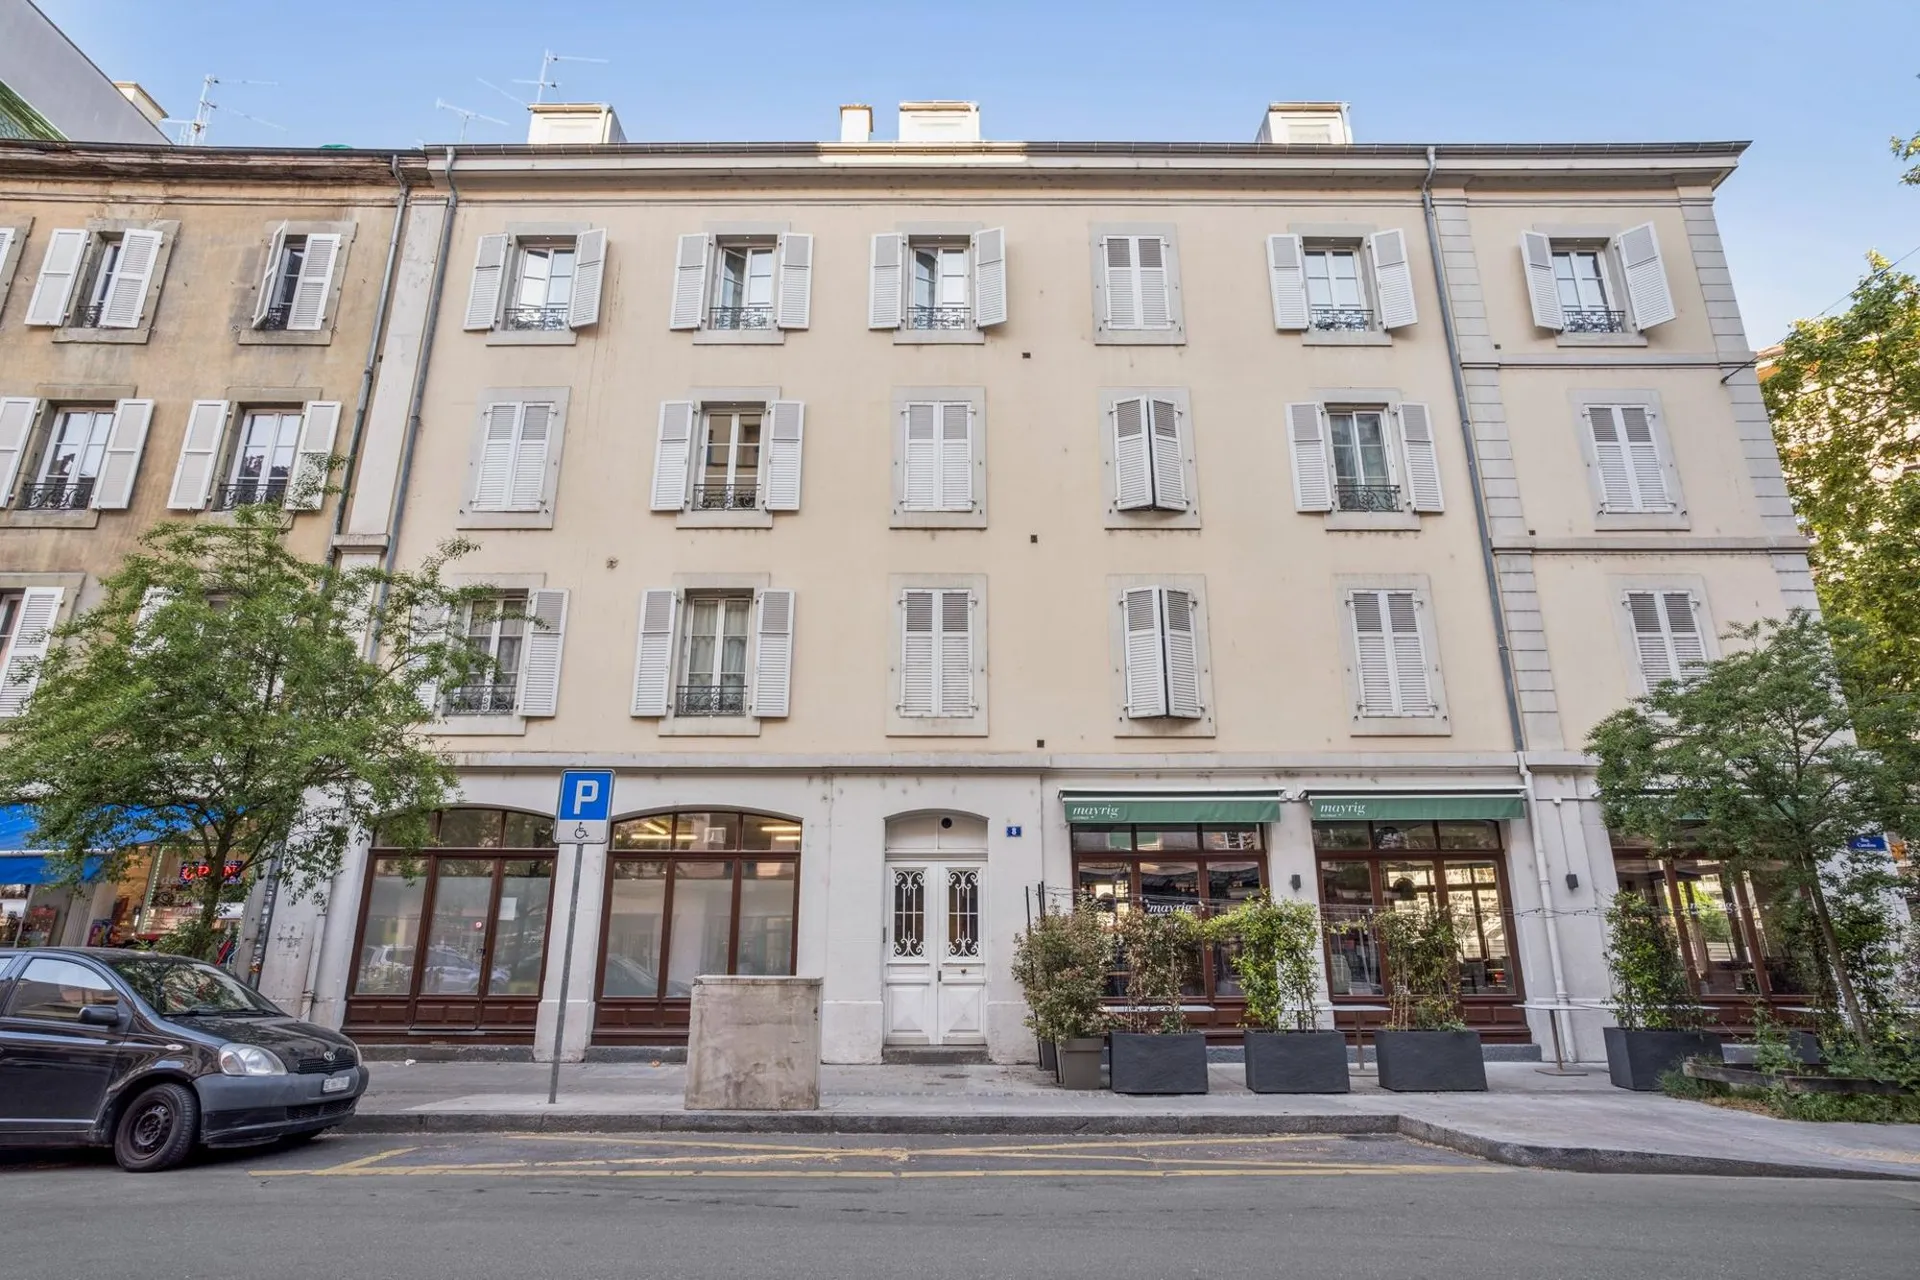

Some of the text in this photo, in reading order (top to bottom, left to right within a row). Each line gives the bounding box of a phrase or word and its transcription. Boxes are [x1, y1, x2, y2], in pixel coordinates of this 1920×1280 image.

[573, 780, 599, 815] P
[1072, 804, 1120, 819] mayrig
[1320, 801, 1366, 816] mayrig
[183, 865, 240, 880] OPN
